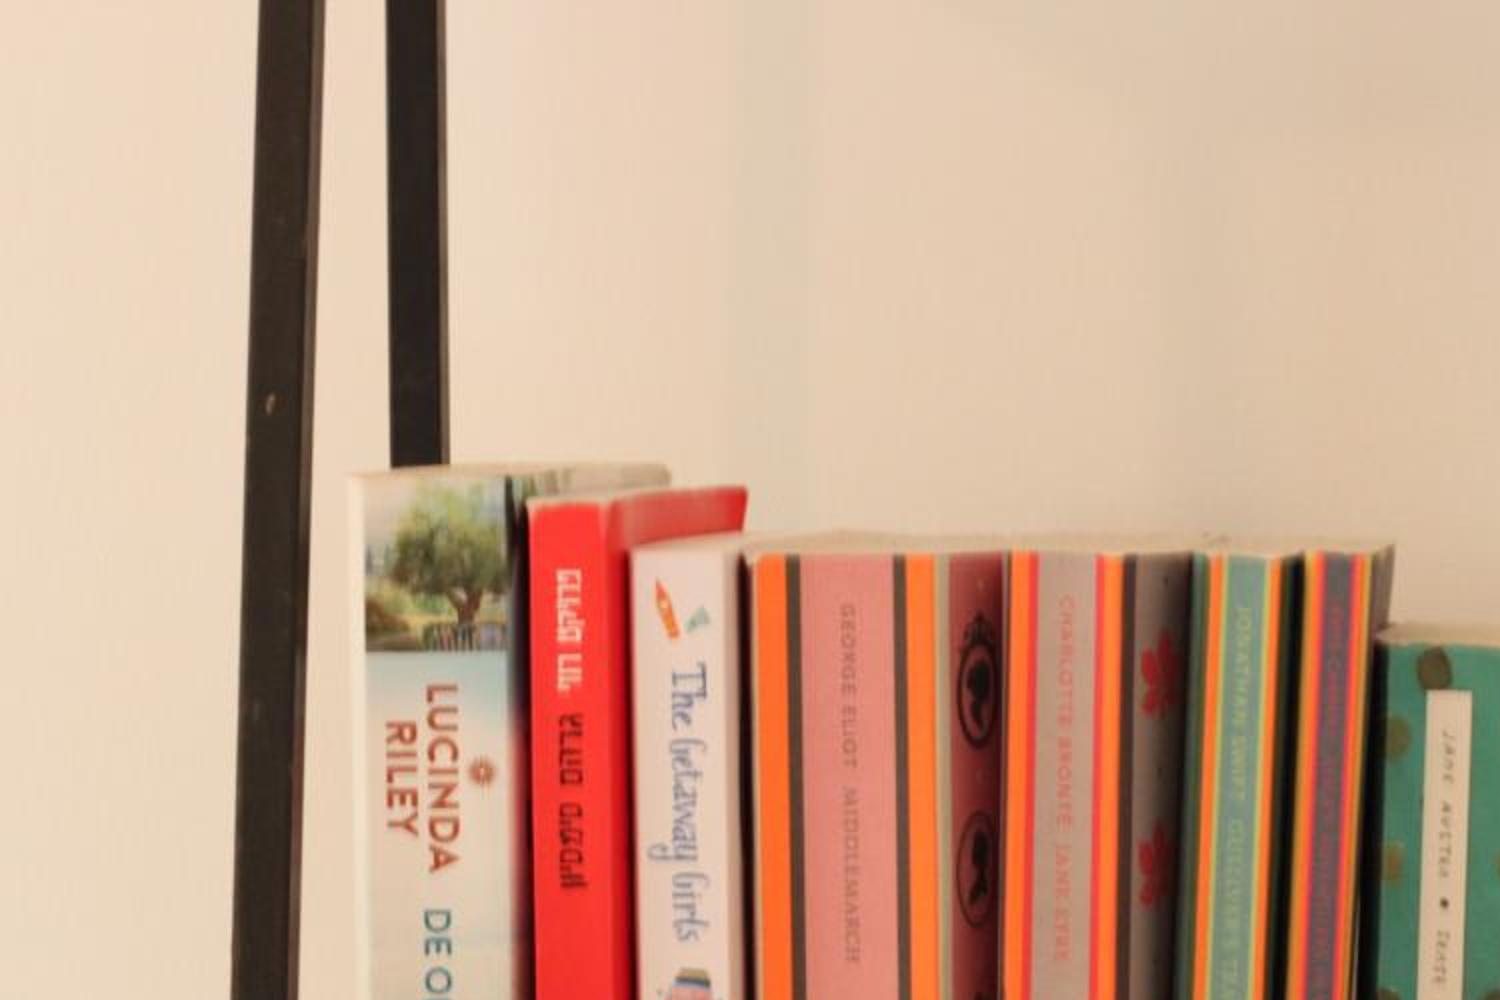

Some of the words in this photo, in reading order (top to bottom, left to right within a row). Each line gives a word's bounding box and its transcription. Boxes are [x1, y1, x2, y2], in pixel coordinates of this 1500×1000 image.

[671, 661, 708, 731] The
[840, 603, 858, 696] GEORGE
[1055, 594, 1077, 728] CHARLOTTE
[385, 720, 419, 838] RILEY
[425, 683, 462, 874] LUCINDA
[840, 704, 859, 770] ELIOT
[648, 737, 709, 863] Getaway
[672, 872, 710, 943] Girls
[842, 784, 861, 964] MIDDLEMARCH
[424, 908, 453, 956] DE
